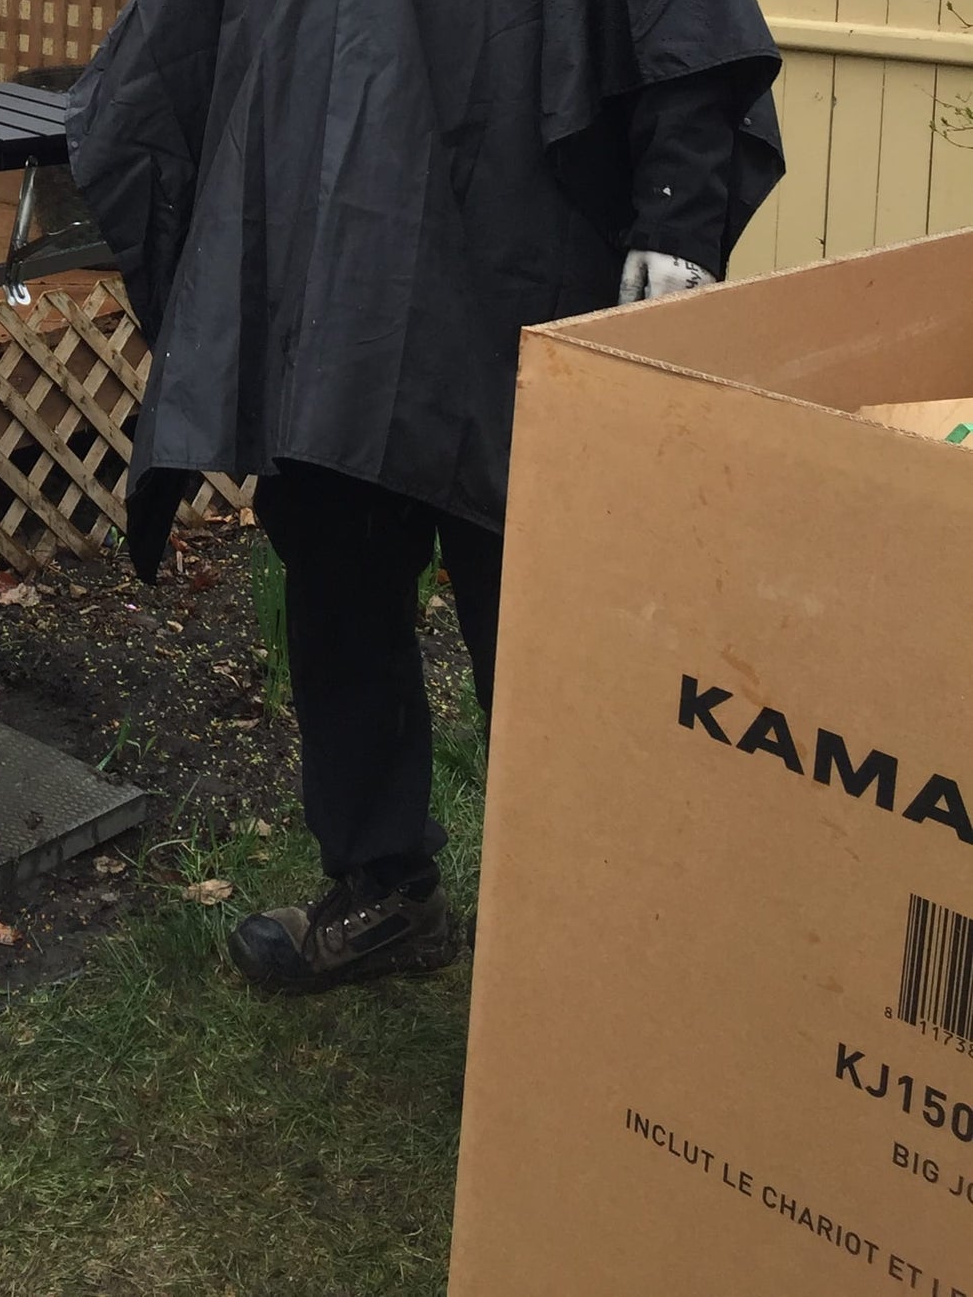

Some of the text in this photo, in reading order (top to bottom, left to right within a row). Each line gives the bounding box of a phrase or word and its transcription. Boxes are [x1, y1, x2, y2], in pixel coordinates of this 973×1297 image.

[678, 674, 973, 846] KAMA
[835, 1042, 973, 1143] KJ150
[626, 1108, 714, 1174] INCLUT
[722, 1162, 753, 1197] LE
[762, 1186, 879, 1265] CHARIOT
[888, 1254, 923, 1290] ET
[892, 1141, 939, 1184] BIG
